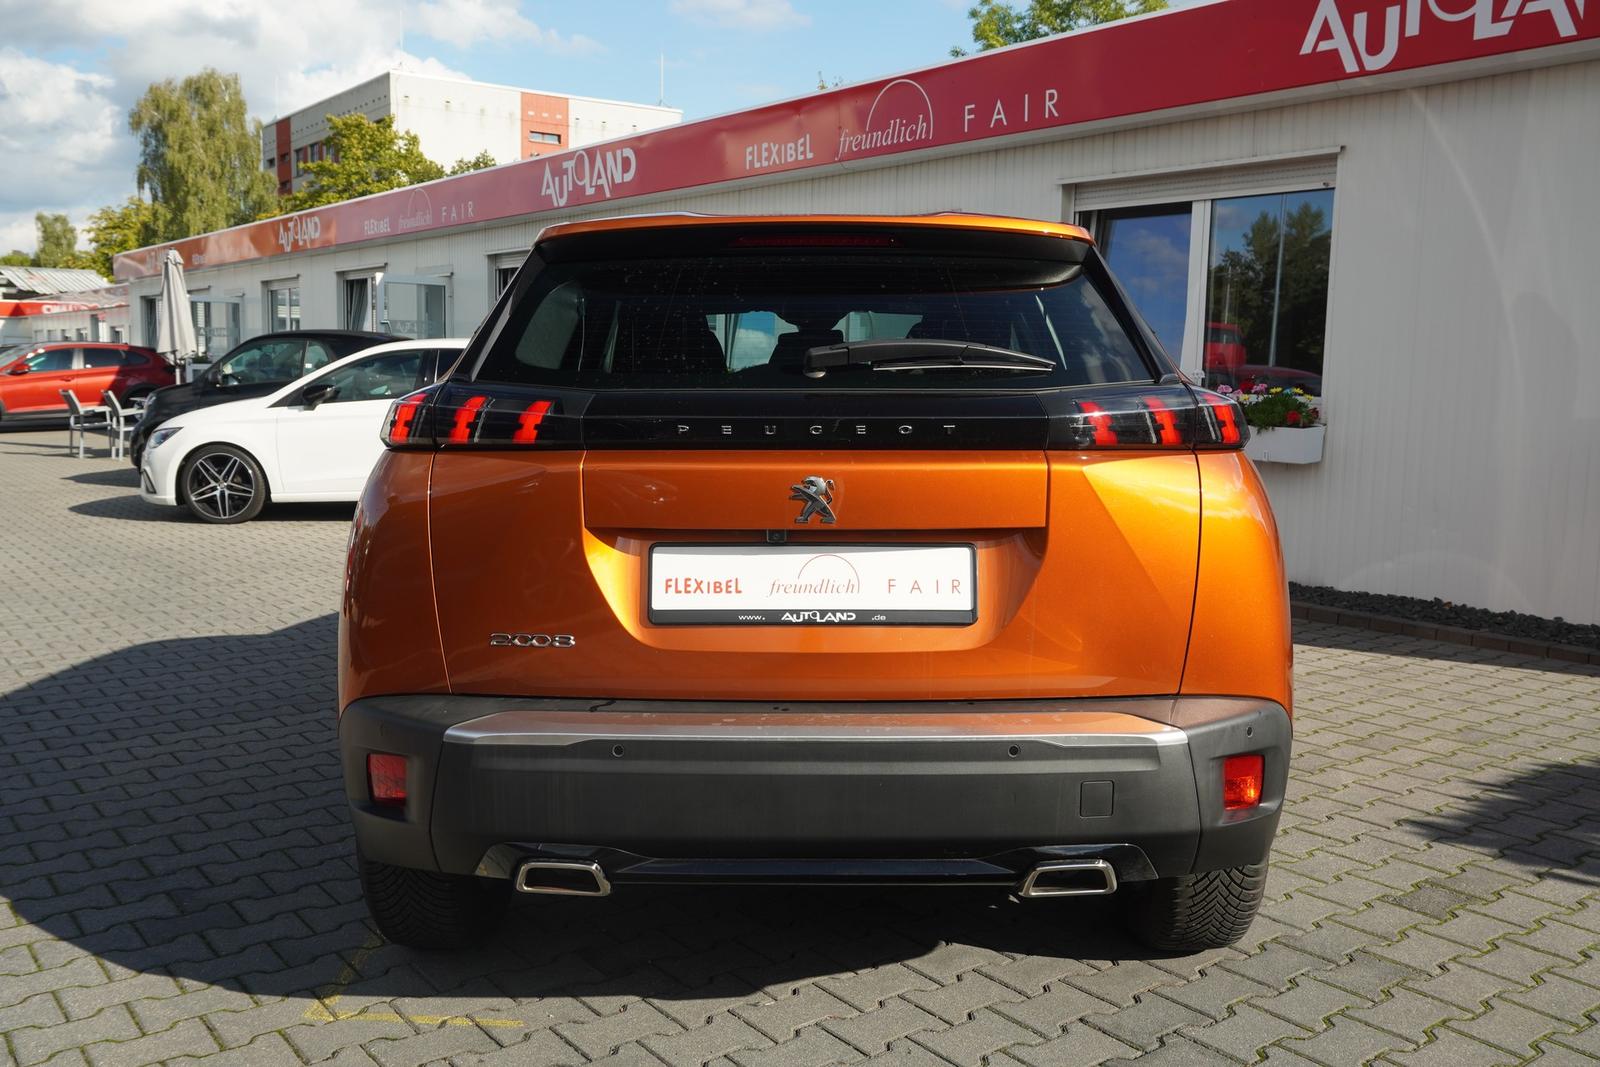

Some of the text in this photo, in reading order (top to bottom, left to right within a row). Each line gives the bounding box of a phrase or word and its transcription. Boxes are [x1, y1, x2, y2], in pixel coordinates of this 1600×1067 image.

[745, 88, 1059, 170] FLEXIBEL freundlich FAIR
[541, 147, 637, 207] AUTOLAND
[364, 215, 391, 236] FLEXIBEL
[441, 200, 475, 224] FAIR
[278, 215, 321, 252] AUTOLAND
[677, 424, 956, 435] PEUGEOT
[664, 577, 962, 598] FLEXIBEL freundlich FAIR
[781, 610, 857, 623] AUTOLAND
[871, 613, 887, 621] .de
[490, 633, 576, 648] 2008
